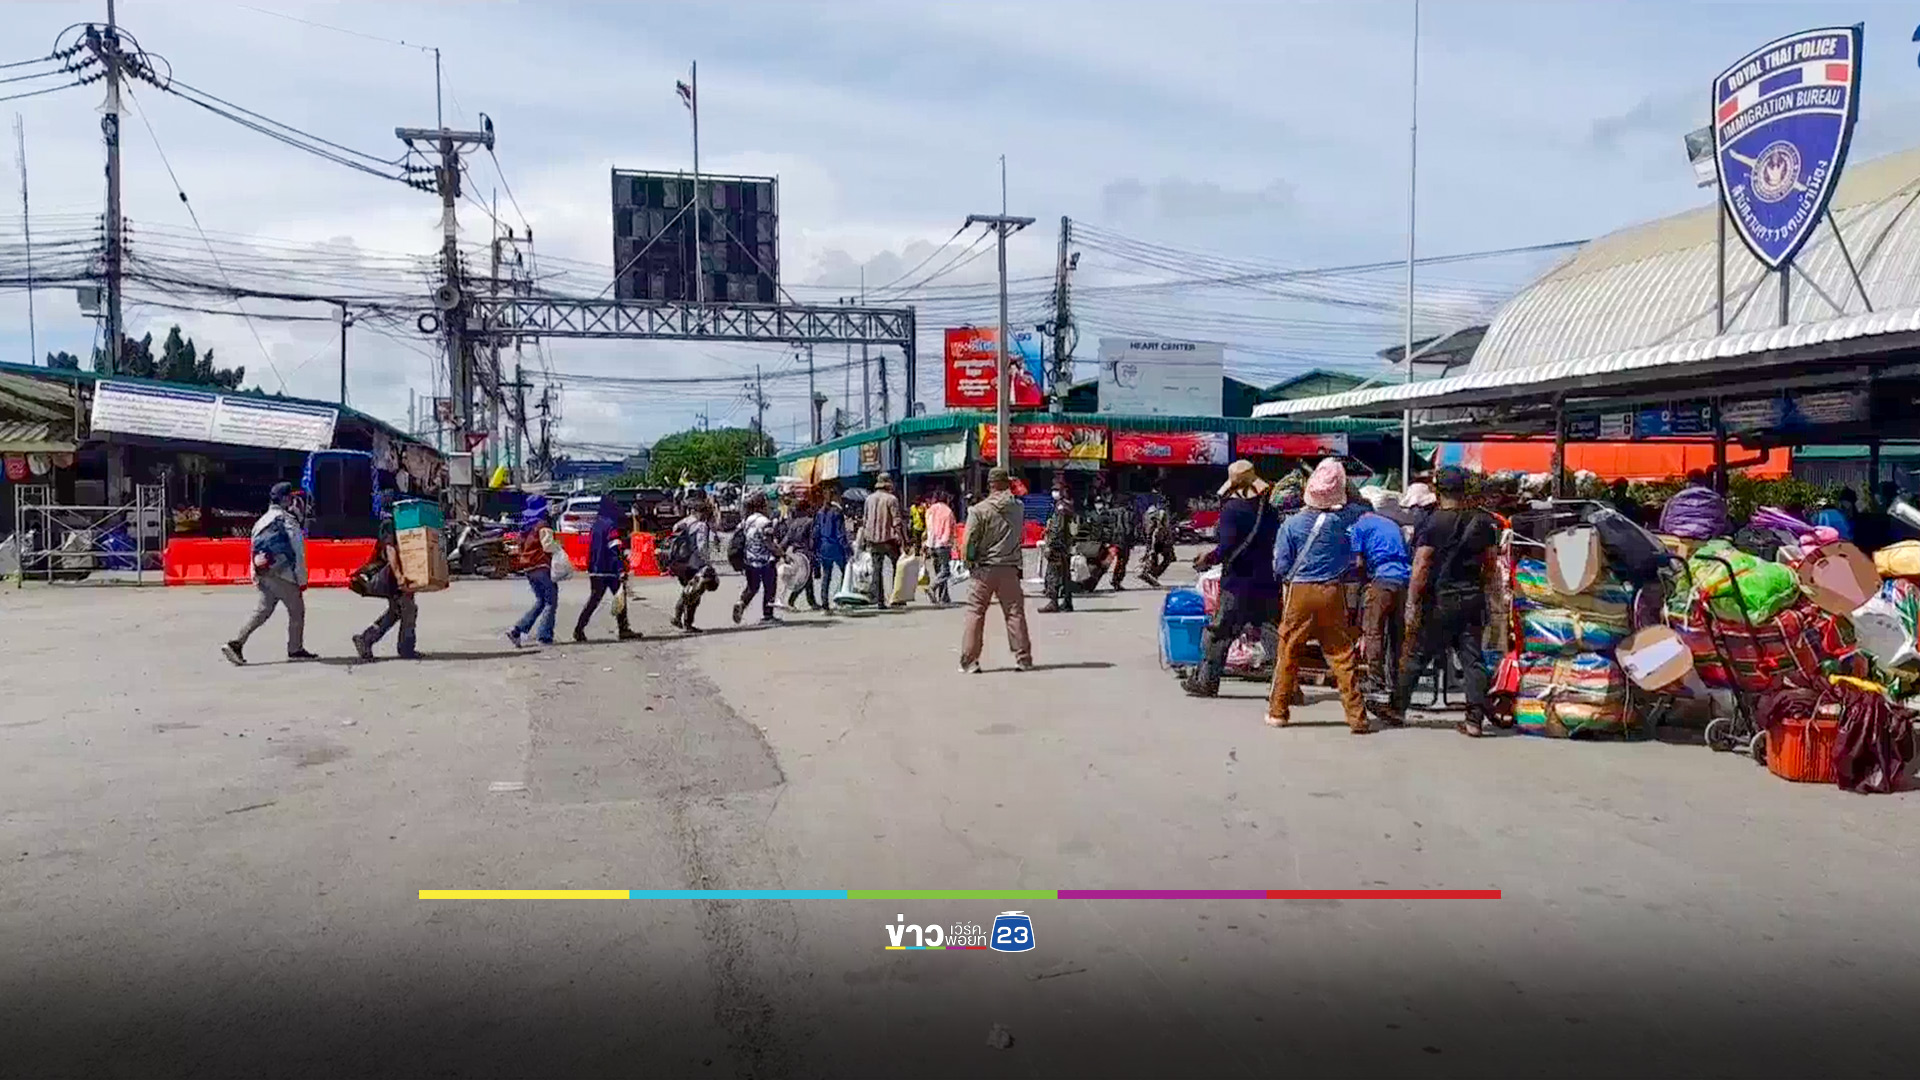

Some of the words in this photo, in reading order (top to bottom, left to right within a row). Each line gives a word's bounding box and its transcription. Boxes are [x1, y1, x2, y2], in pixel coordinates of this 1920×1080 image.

[1727, 64, 1764, 91] ROYAL
[1763, 46, 1793, 71] THAI
[1792, 37, 1838, 58] POLICE
[1723, 92, 1794, 140] IMMIGRATION
[1796, 88, 1842, 108] BUREAU
[1130, 342, 1159, 351] HEART
[1161, 342, 1196, 351] CENTER
